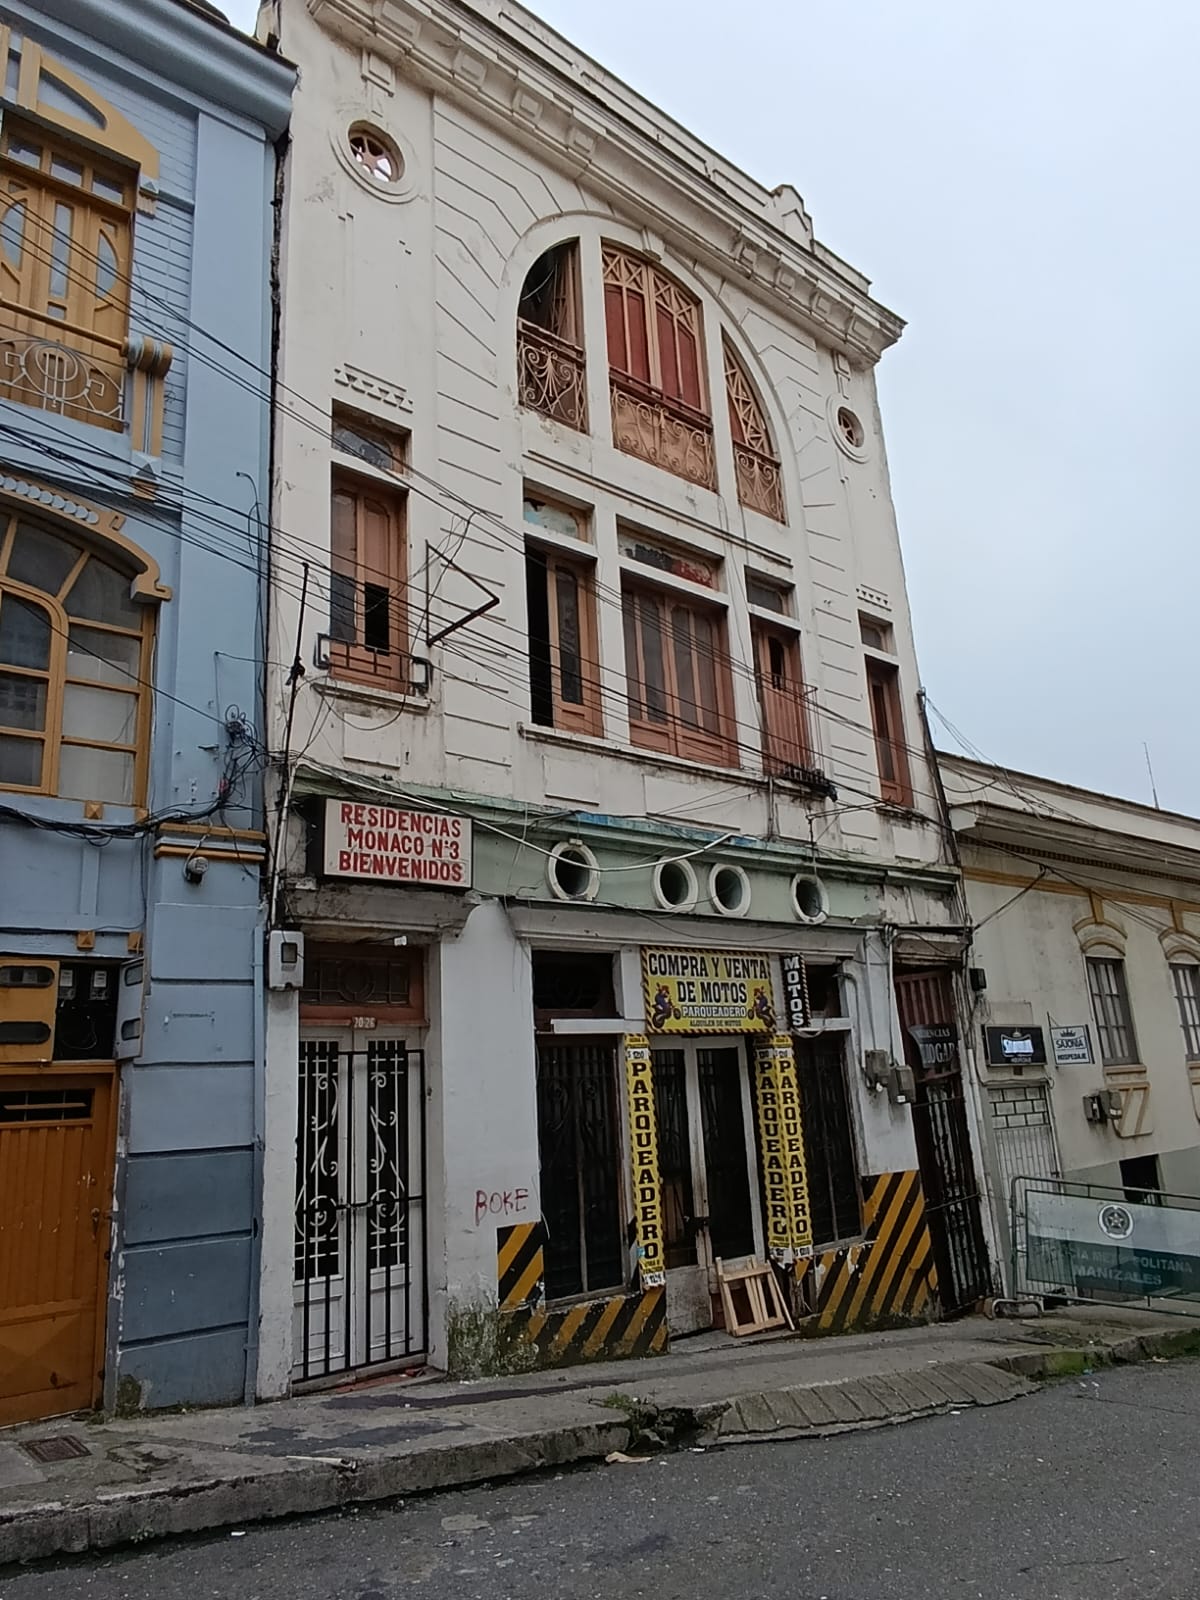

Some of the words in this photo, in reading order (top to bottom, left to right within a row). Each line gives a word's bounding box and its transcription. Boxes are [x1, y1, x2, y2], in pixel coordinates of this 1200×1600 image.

[341, 803, 461, 838] RESIDENCIAS
[347, 827, 424, 855] MONACO
[339, 850, 462, 882] BIENVENIDOS
[648, 952, 709, 978] COMPRA
[711, 956, 720, 978] Y
[726, 957, 768, 979] VENTA
[677, 981, 697, 1003] DE
[701, 982, 748, 1004] MOTOS
[784, 956, 804, 1026] MOTOS
[682, 1005, 747, 1018] PARQUEADERO
[631, 1062, 659, 1259] PARQUEADERO
[758, 1061, 787, 1234] PARQUEADERO
[779, 1060, 807, 1234] PARQUEADERO
[1075, 1265, 1162, 1285] MANIZALES
